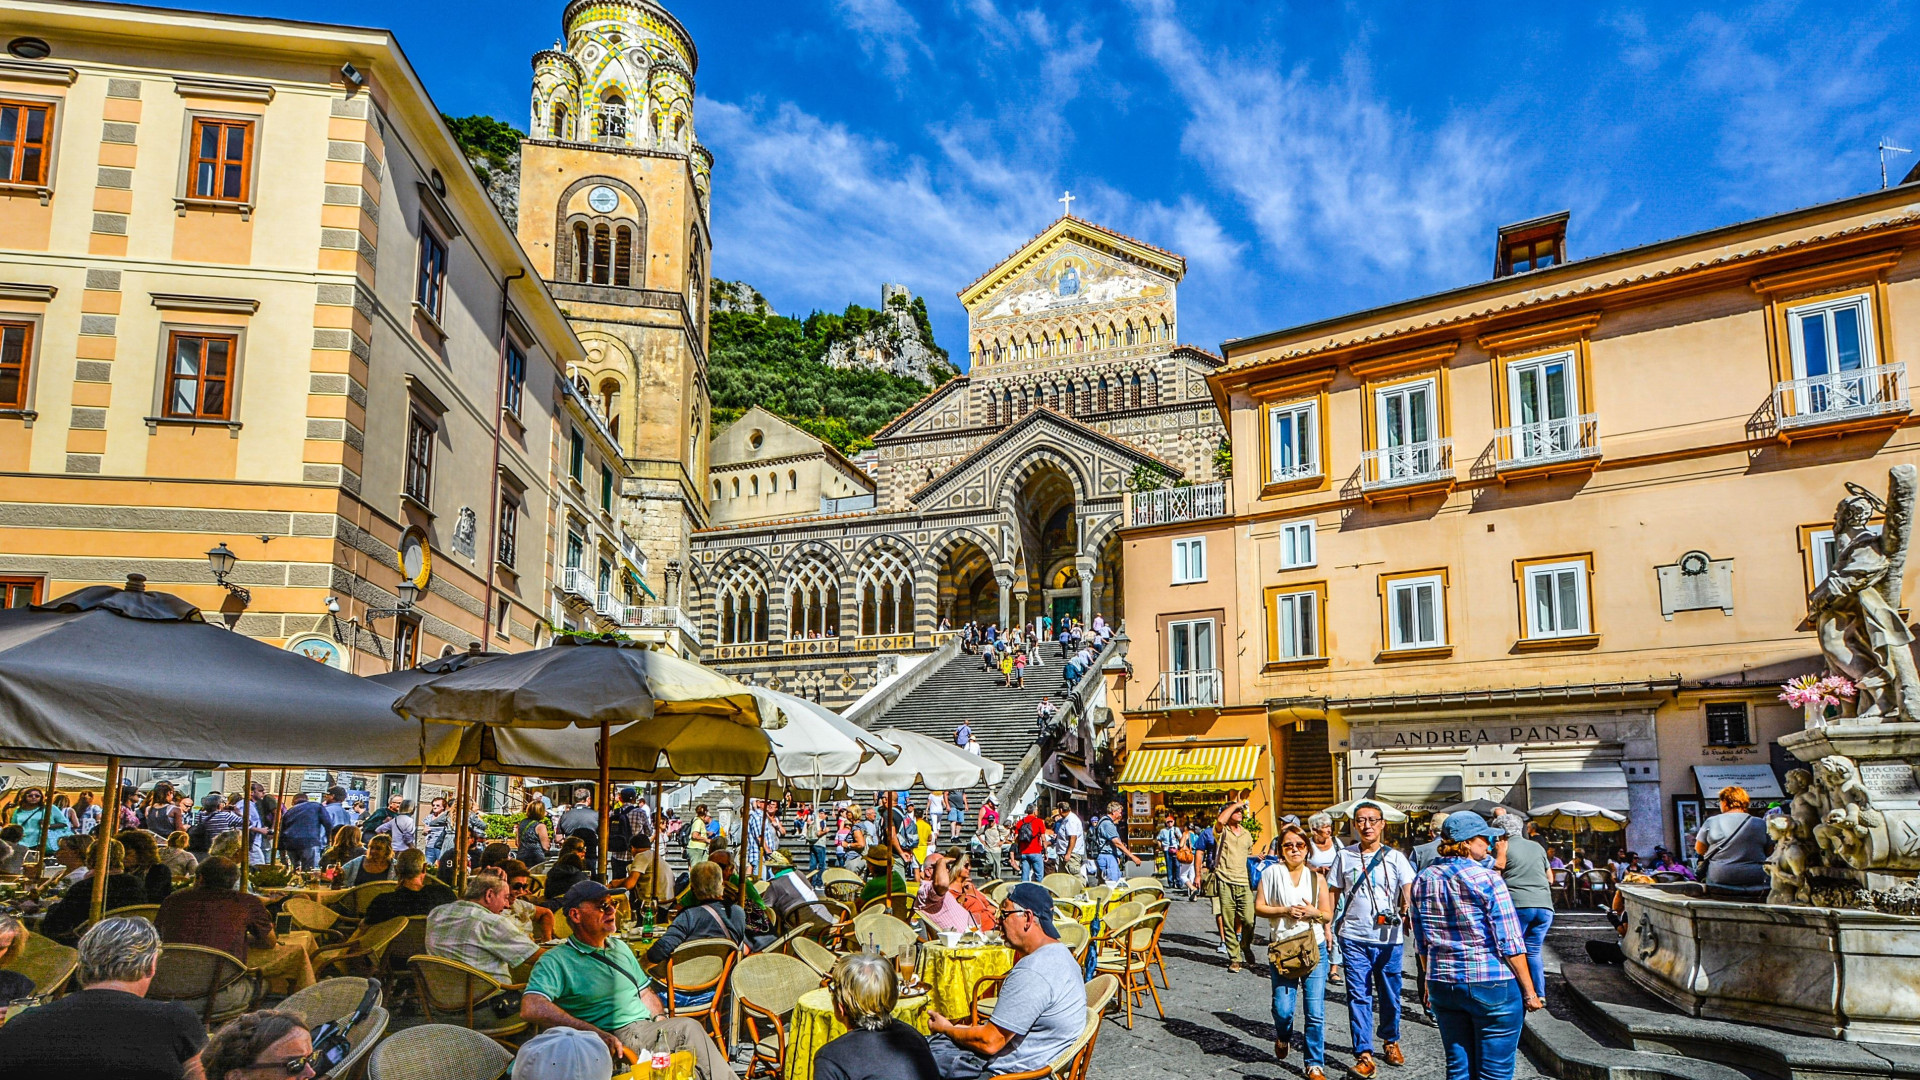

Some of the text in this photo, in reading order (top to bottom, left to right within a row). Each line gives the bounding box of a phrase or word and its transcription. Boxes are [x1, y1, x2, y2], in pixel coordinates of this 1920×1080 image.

[1394, 724, 1599, 745] ANDREA PANSA
[1394, 802, 1439, 810] Pasticceria
[446, 860, 453, 868] 9
